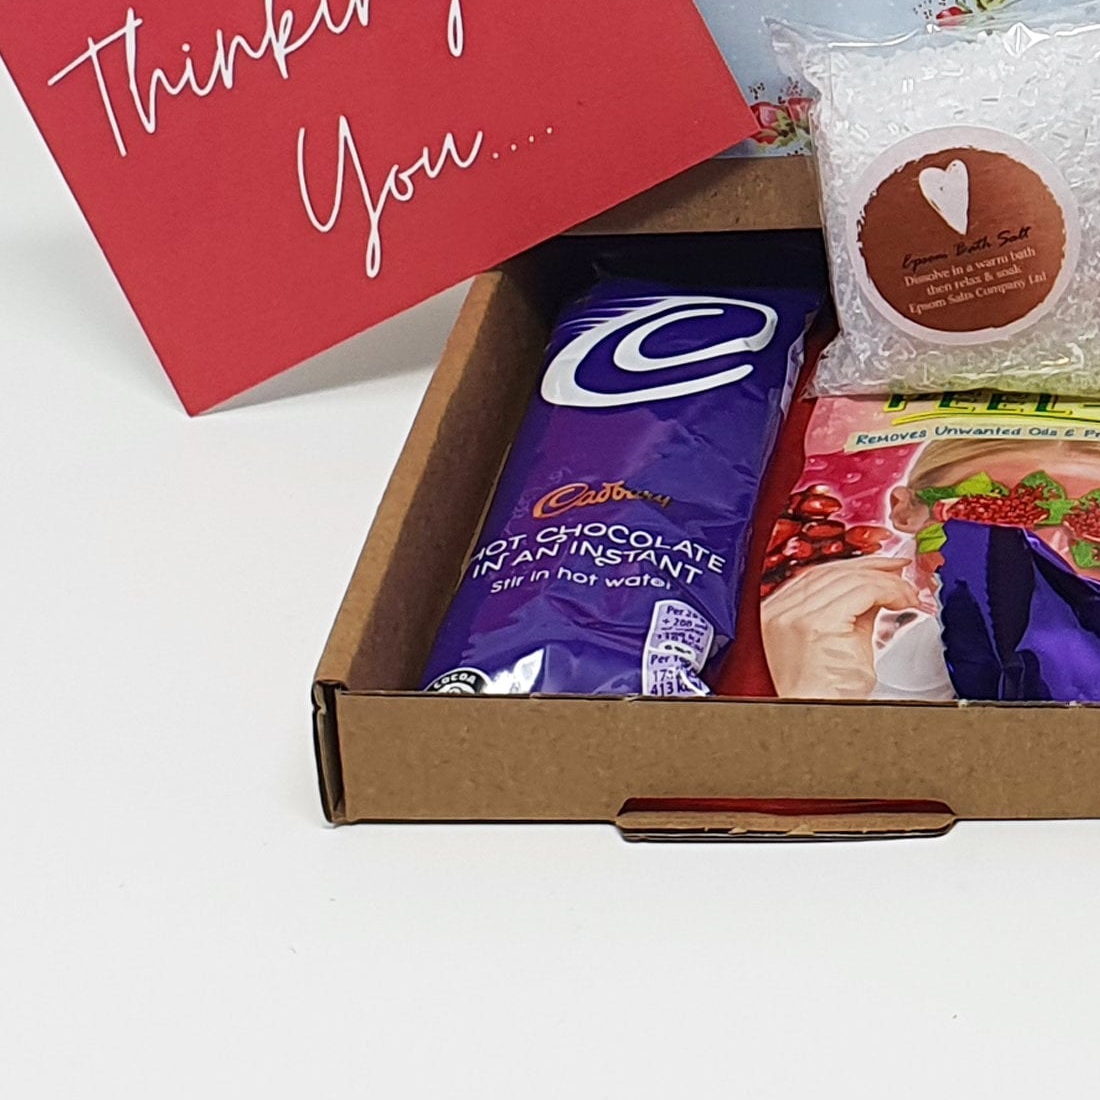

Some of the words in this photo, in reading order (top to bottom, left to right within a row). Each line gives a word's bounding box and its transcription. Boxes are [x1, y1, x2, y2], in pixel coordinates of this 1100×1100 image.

[996, 226, 1032, 247] Salt
[904, 266, 950, 287] Dissolve
[951, 263, 964, 277] in
[966, 264, 974, 273] a
[975, 254, 1009, 270] warm
[1009, 246, 1037, 261] bath
[926, 281, 953, 296] then
[954, 274, 983, 290] relax
[984, 269, 995, 282] &
[996, 264, 1023, 278] soak
[908, 298, 948, 315] Epsom
[975, 279, 1027, 299] Company
[1028, 271, 1047, 286] Ltd
[472, 552, 511, 579] IN
[511, 542, 560, 567] AN
[569, 540, 704, 585] INSTANT
[535, 522, 726, 574] CHOCOLATE
[529, 570, 550, 583] in
[556, 566, 599, 586] hot
[432, 672, 477, 690] COCOA
